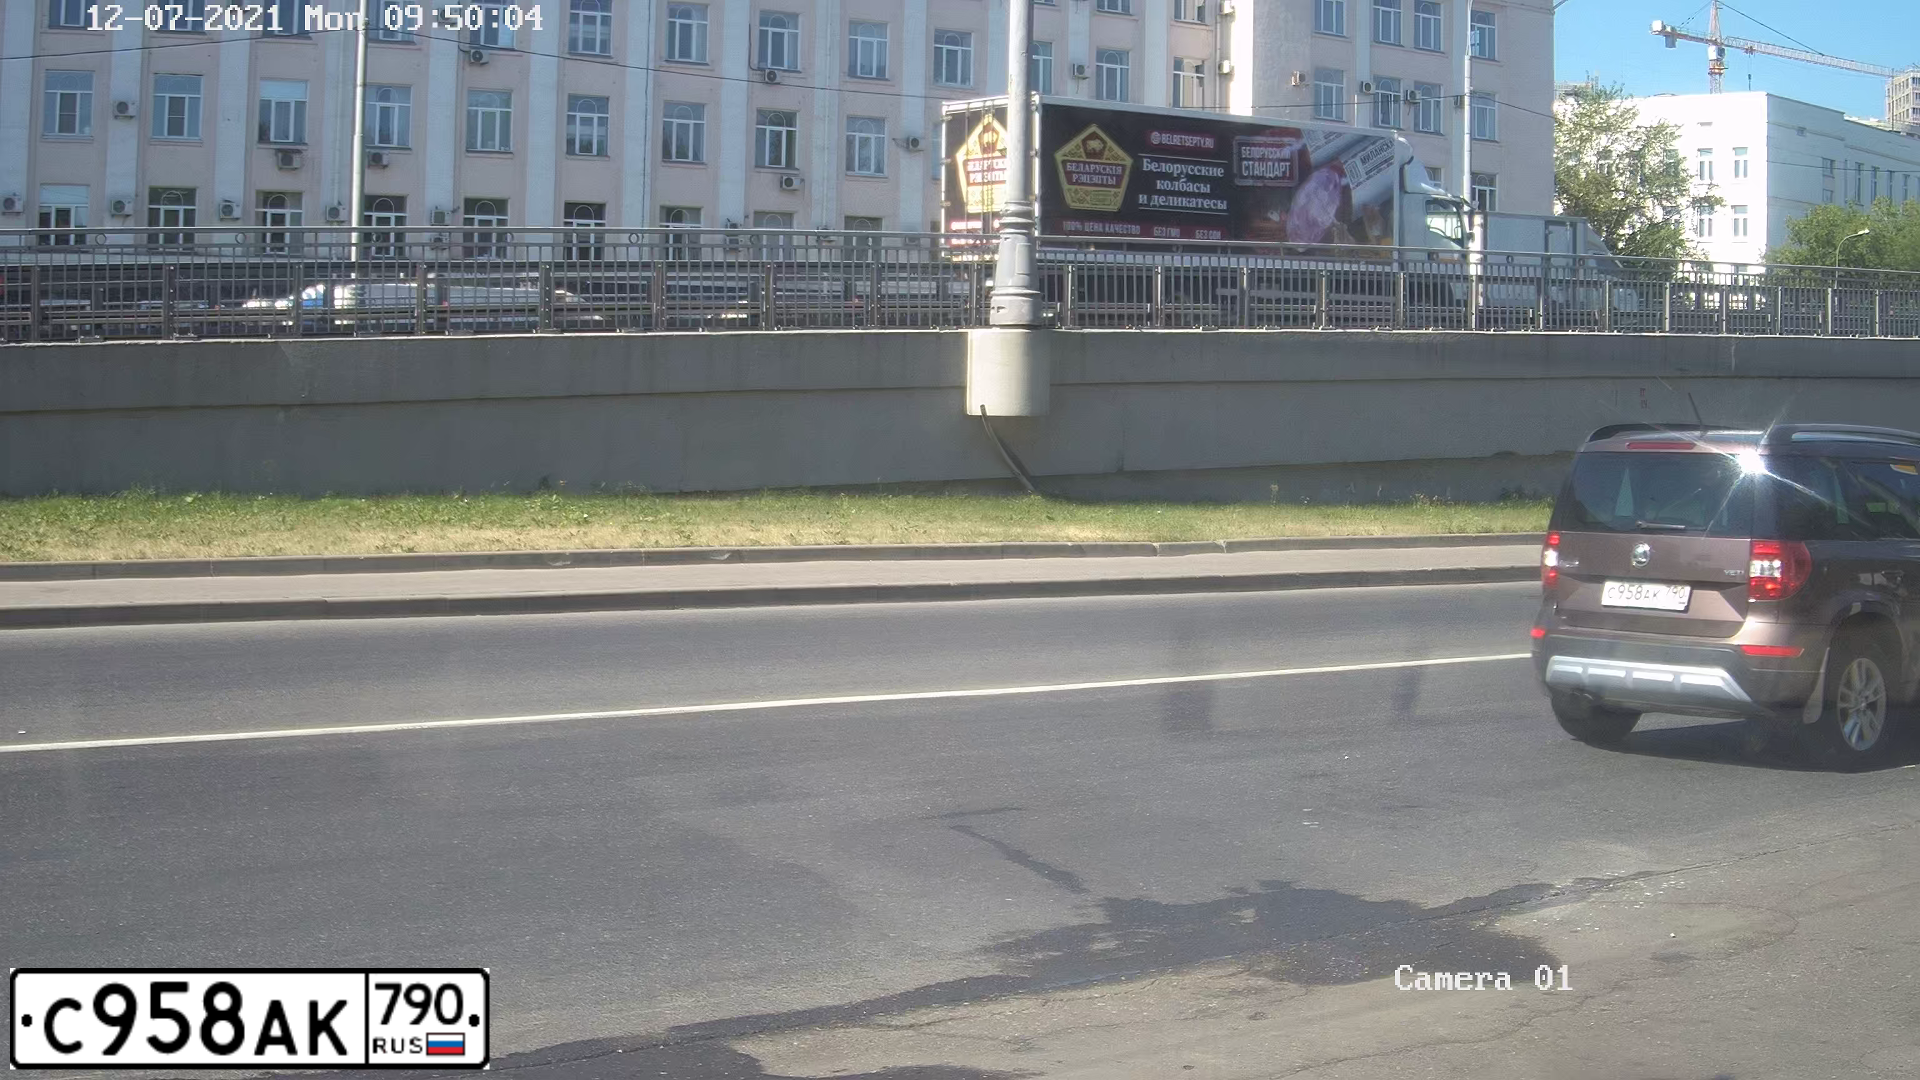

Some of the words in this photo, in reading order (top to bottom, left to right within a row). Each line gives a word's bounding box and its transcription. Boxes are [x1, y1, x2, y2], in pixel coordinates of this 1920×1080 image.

[1142, 158, 1225, 178] Белорусские
[1242, 160, 1291, 178] СТАНДАРТ
[1156, 178, 1211, 193] колбасы
[1138, 194, 1148, 205] и
[1149, 195, 1228, 210] деликатесы
